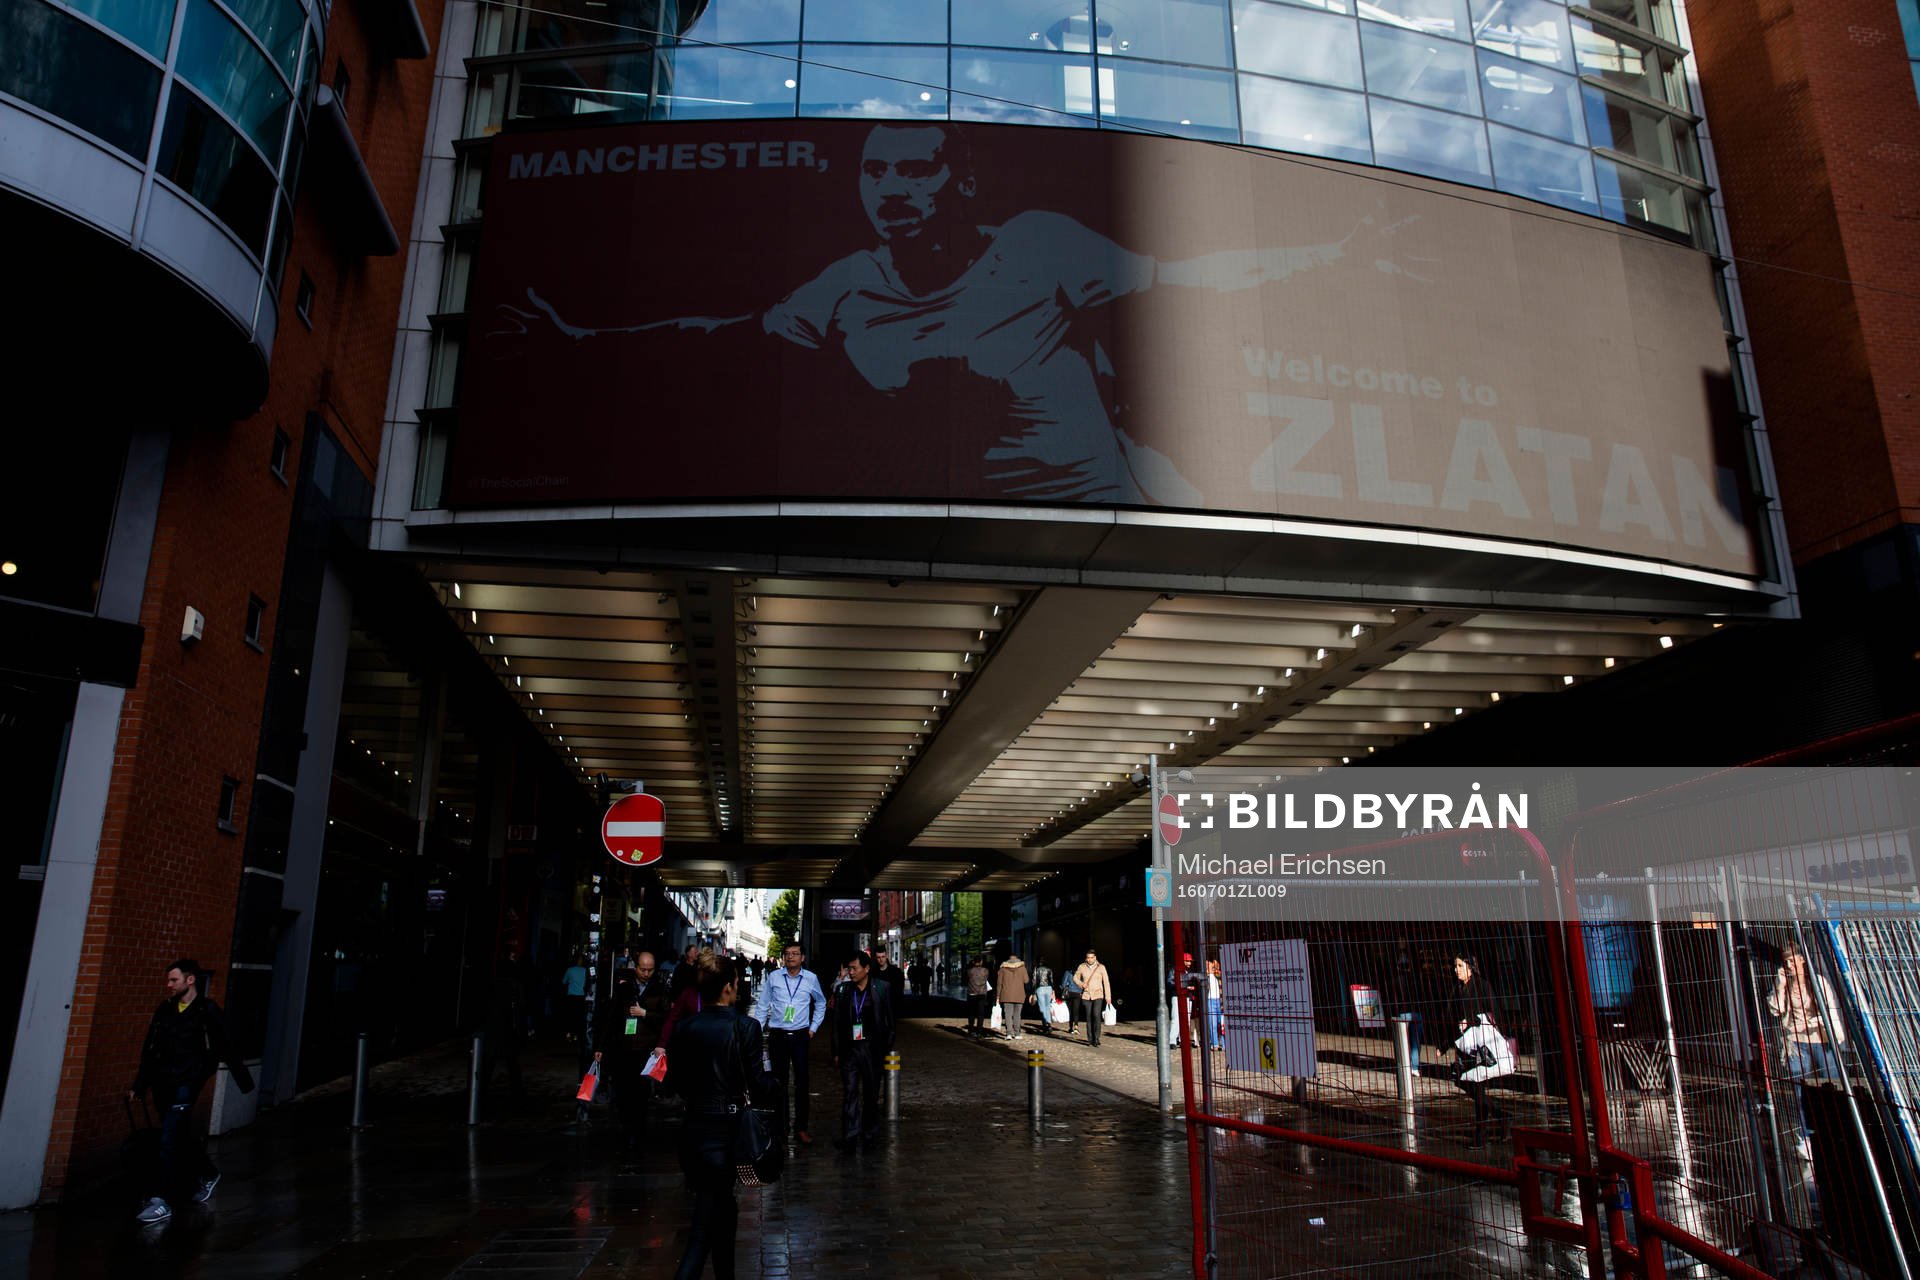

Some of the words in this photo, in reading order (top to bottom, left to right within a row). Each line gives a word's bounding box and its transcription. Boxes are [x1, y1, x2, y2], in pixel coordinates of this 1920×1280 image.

[508, 139, 829, 182] MANCHESTER,
[1241, 345, 1446, 401] Welcome
[1457, 375, 1500, 408] to
[1245, 391, 1752, 558] ZLATAN
[1807, 853, 1911, 883] SAMSUNG
